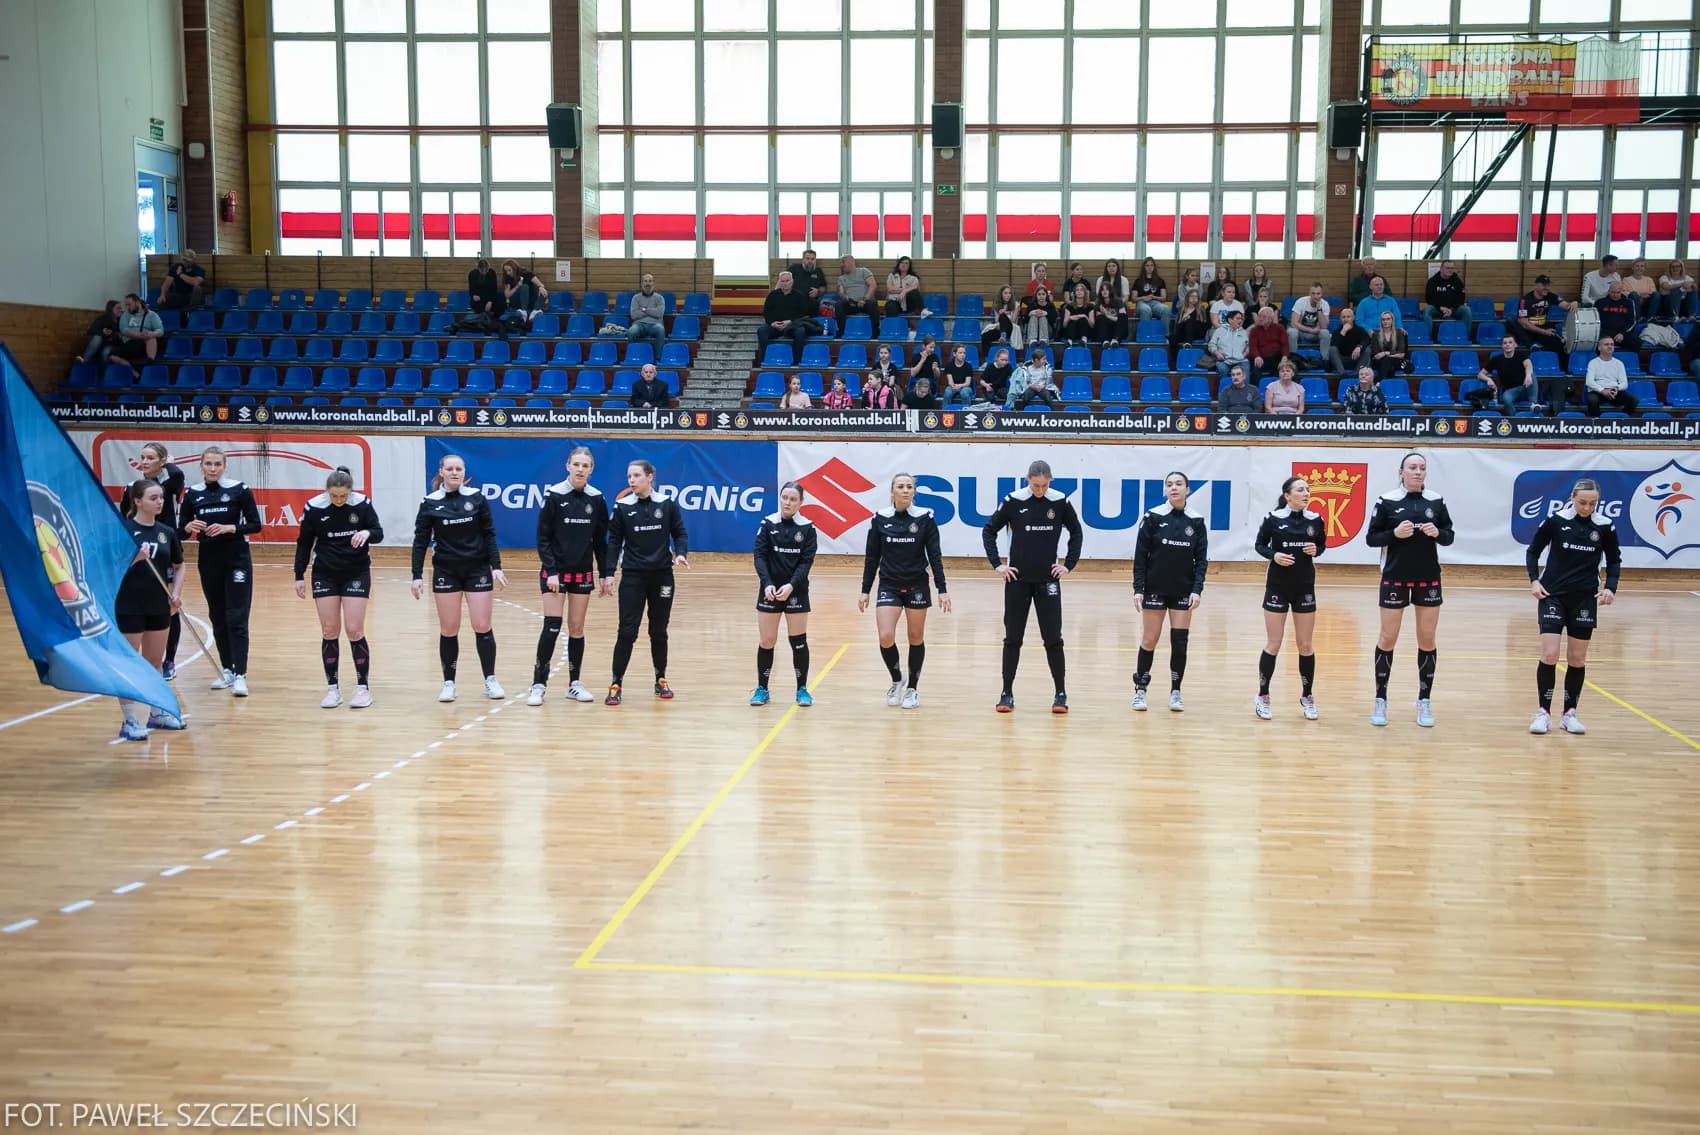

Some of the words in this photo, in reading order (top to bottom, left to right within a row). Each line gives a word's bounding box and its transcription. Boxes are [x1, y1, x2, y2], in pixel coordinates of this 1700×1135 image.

[1450, 48, 1552, 66] KORONA
[1436, 69, 1563, 87] HANDBALL
[1471, 91, 1529, 107] FANS
[52, 404, 195, 422] ww.koronahandball.pl
[274, 408, 433, 426] www.koronahandball.pl
[511, 411, 674, 430] www.koronahandball.pl
[752, 412, 915, 430] www.koronahandball.
[1001, 414, 1171, 433] www.koronahandball.pl
[1254, 417, 1430, 435] www.koronahandball.pl
[1516, 420, 1700, 438] www.koronahandball.pl
[480, 484, 551, 509] PGN
[658, 485, 765, 512] PGNiG
[1547, 500, 1623, 518] PiG
